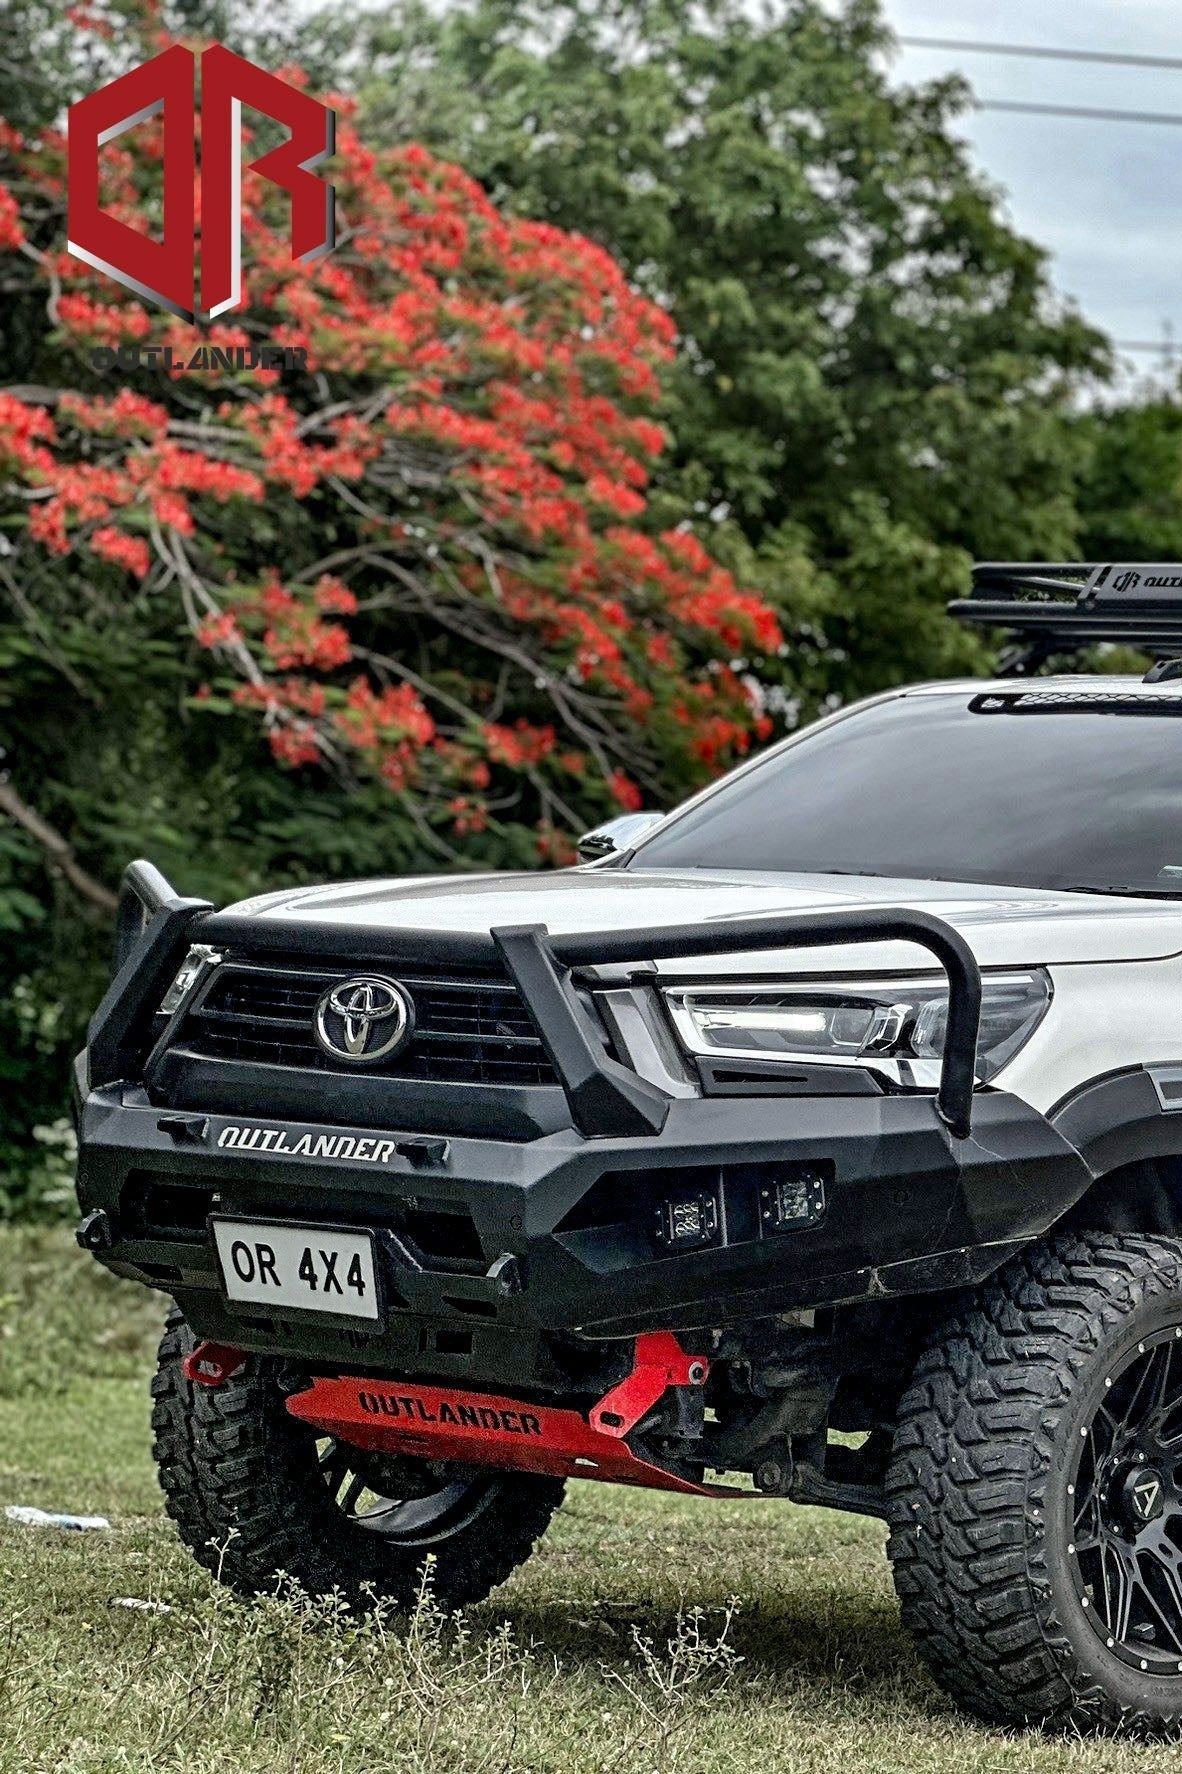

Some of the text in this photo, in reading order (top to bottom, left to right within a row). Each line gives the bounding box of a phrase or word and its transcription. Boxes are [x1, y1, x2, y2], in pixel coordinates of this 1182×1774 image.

[217, 1126, 396, 1163] OUTLANDER
[231, 1240, 366, 1297] OR 4X4
[358, 1391, 542, 1436] OUTLANDER
